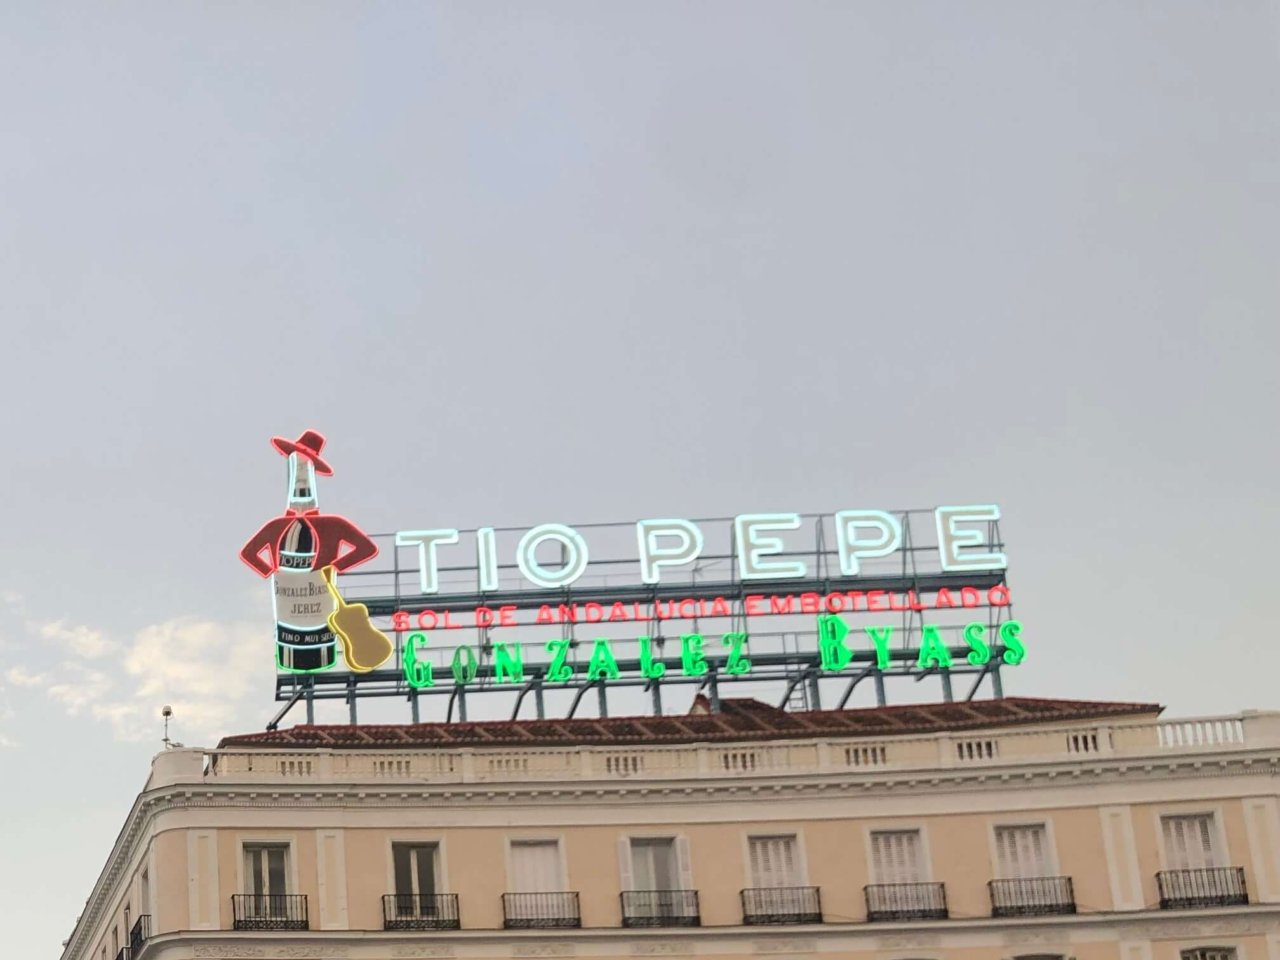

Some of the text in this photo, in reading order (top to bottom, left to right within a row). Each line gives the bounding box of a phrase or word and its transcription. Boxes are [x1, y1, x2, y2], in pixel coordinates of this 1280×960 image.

[395, 504, 1008, 594] TIO PEPE
[291, 603, 321, 614] JEREZ
[392, 583, 1011, 632] SOL DE ANDALUCIA EMBOTELLADO
[281, 631, 300, 642] FINO
